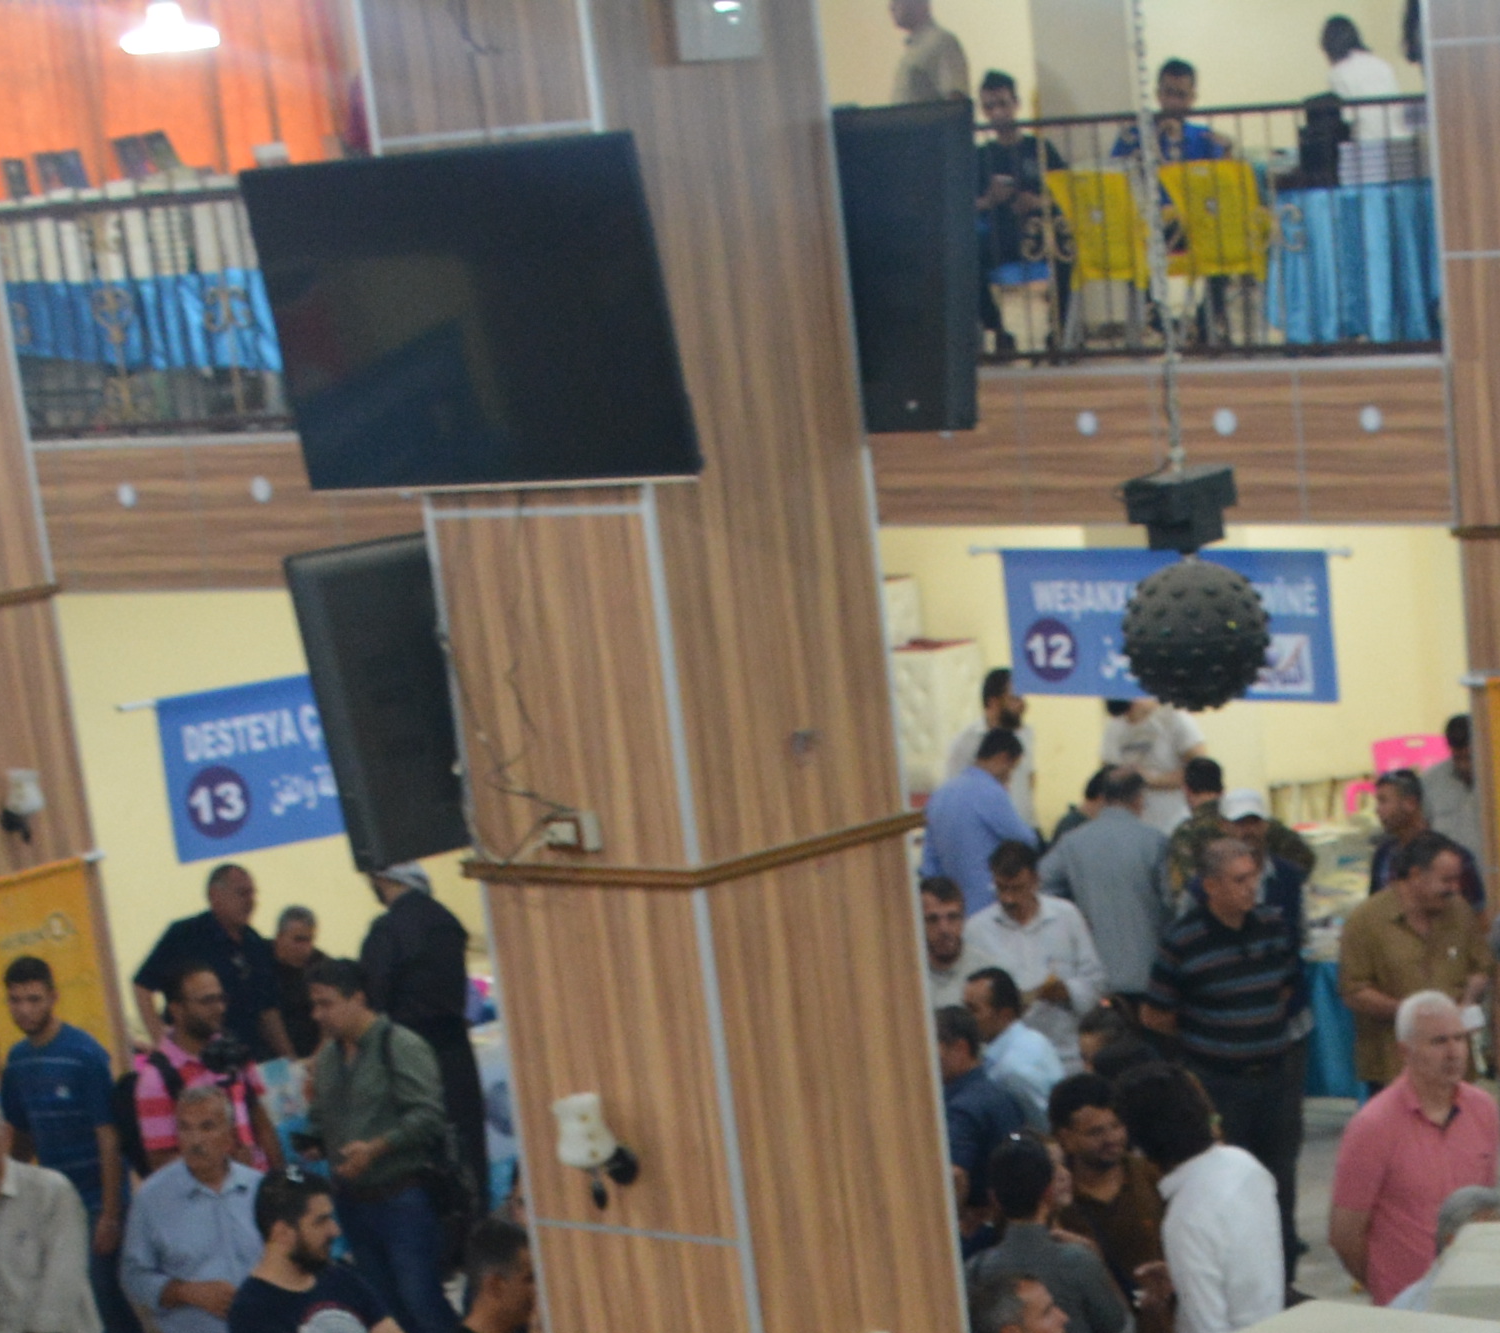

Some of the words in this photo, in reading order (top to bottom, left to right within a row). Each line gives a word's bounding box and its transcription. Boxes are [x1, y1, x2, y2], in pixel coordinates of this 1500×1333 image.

[1026, 635, 1075, 668] 12
[180, 708, 300, 763] DESTEYA
[188, 782, 247, 825] 13
